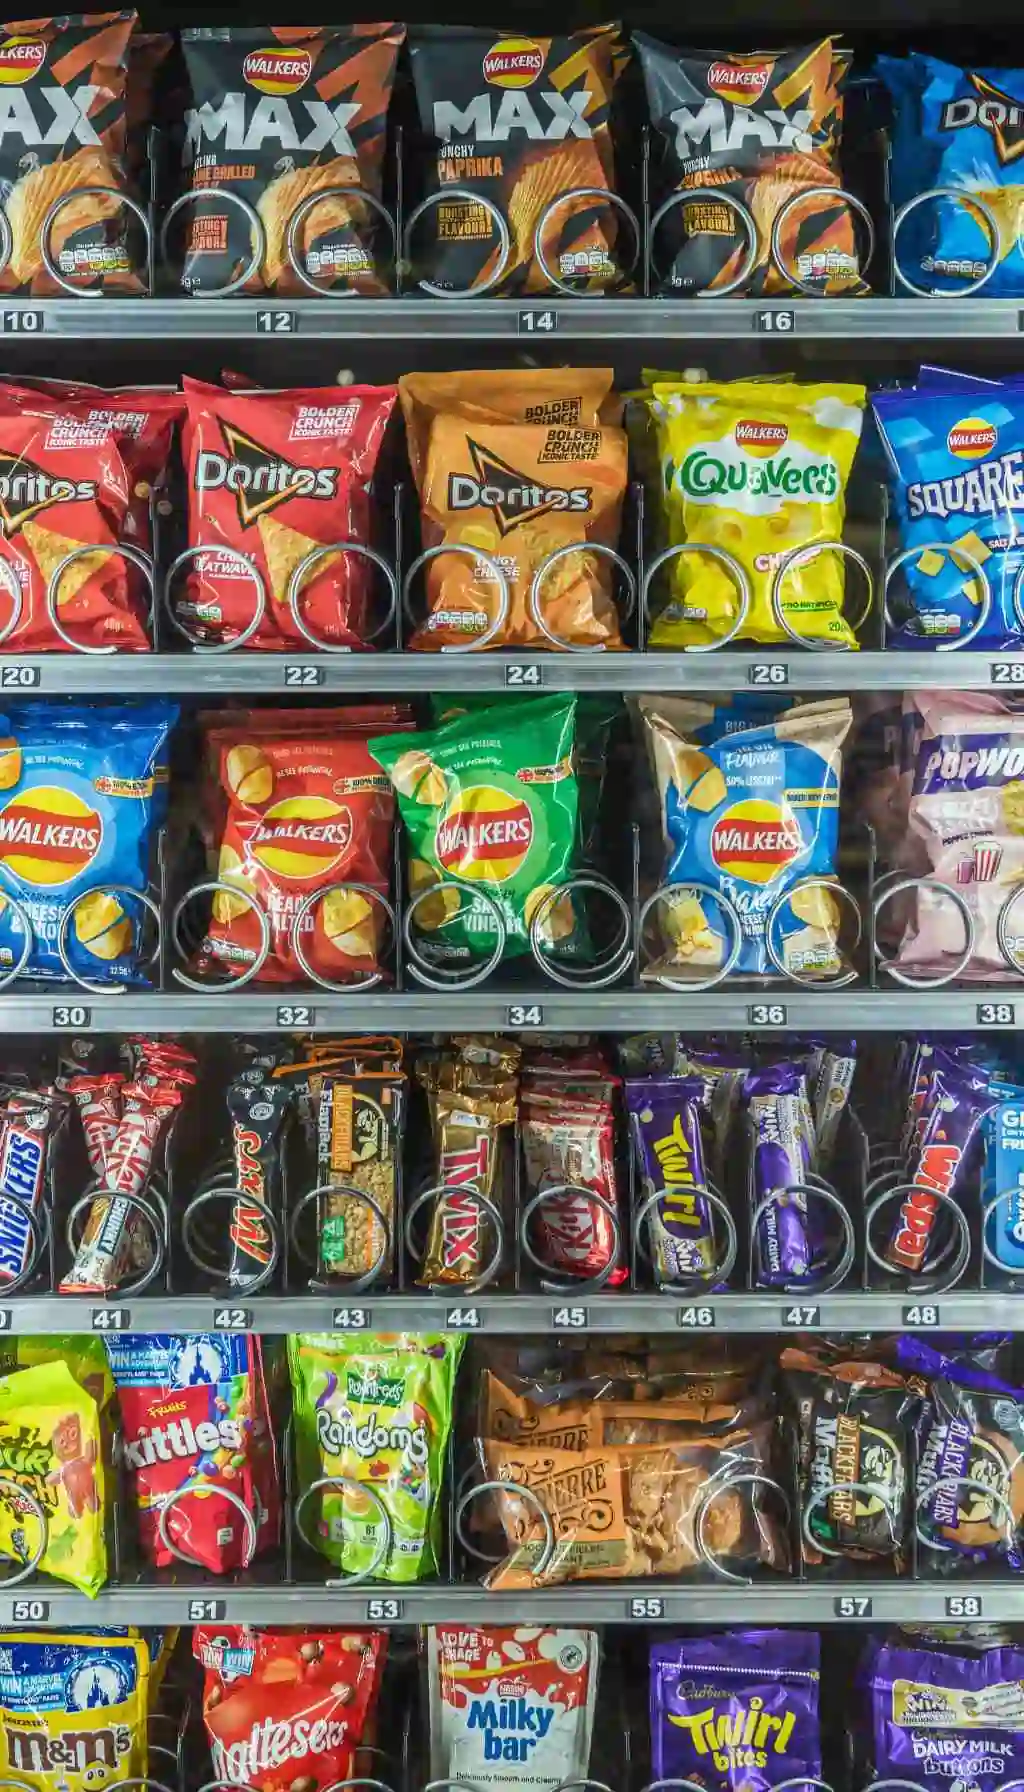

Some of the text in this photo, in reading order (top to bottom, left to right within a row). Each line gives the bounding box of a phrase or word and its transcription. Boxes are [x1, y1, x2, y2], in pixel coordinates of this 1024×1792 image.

[245, 55, 310, 77] WALKERS
[485, 54, 541, 73] WALKERS
[709, 68, 768, 87] WALKERS
[186, 92, 362, 158] MAX
[433, 90, 593, 142] MAX
[670, 98, 816, 160] MAX
[437, 156, 504, 181] PAPRIKA
[7, 312, 38, 331] 10
[259, 312, 291, 331] 12
[522, 312, 553, 331] 14
[760, 311, 791, 330] 16
[298, 407, 357, 418] BOLDER
[525, 401, 579, 418] BOLDER
[295, 417, 354, 429] CRUNCH
[735, 424, 788, 440] WALKERS
[51, 428, 108, 439] CRUNCH
[547, 429, 601, 441] BOLDER
[949, 431, 997, 448] WALKERS
[544, 441, 601, 453] CRUNCH
[196, 452, 337, 497] Doritos
[451, 476, 589, 511] Doritos
[3, 667, 35, 686] 20
[287, 666, 318, 684] 22
[507, 666, 539, 684] 24
[754, 665, 785, 683] 26
[994, 664, 1024, 682] 28
[0, 818, 99, 851] WALKERS
[257, 822, 349, 845] WALKERS
[438, 817, 531, 851] WALKERS
[714, 830, 803, 853] WALKERS
[463, 914, 521, 933] VINEAR
[54, 1007, 85, 1025] 30
[277, 1006, 309, 1024] 32
[509, 1006, 541, 1024] 34
[753, 1006, 784, 1024] 36
[981, 1005, 1012, 1023] 38
[652, 1112, 701, 1226] Twirl
[441, 1134, 491, 1269] TWIX
[893, 1144, 962, 1257] Wispa
[767, 1236, 781, 1273] DAIRY
[93, 1310, 122, 1328] 41
[215, 1310, 246, 1327] 42
[334, 1310, 365, 1327] 43
[447, 1309, 479, 1326] 44
[555, 1308, 586, 1326] 45
[681, 1308, 712, 1325] 46
[787, 1308, 817, 1325] 47
[906, 1307, 937, 1325] 48
[147, 1400, 187, 1419] Fruits
[315, 1407, 430, 1466] Randoms
[832, 1416, 859, 1523] BLACKFRARS
[15, 1602, 44, 1620] 50
[190, 1601, 217, 1619] 51
[368, 1601, 398, 1619] 53
[631, 1600, 661, 1617] 55
[839, 1597, 868, 1616] 57
[950, 1597, 979, 1616] 58
[441, 1631, 494, 1648] LOVE TO
[442, 1647, 481, 1661] SHARE
[675, 1679, 738, 1701] Cadbury
[466, 1697, 555, 1738] Milky
[667, 1696, 797, 1755] Twirl
[483, 1728, 537, 1761] bar
[913, 1739, 1014, 1758] DAIRY MILK
[712, 1745, 768, 1772] bites
[923, 1757, 1005, 1777] buttons
[521, 1774, 535, 1784] and
